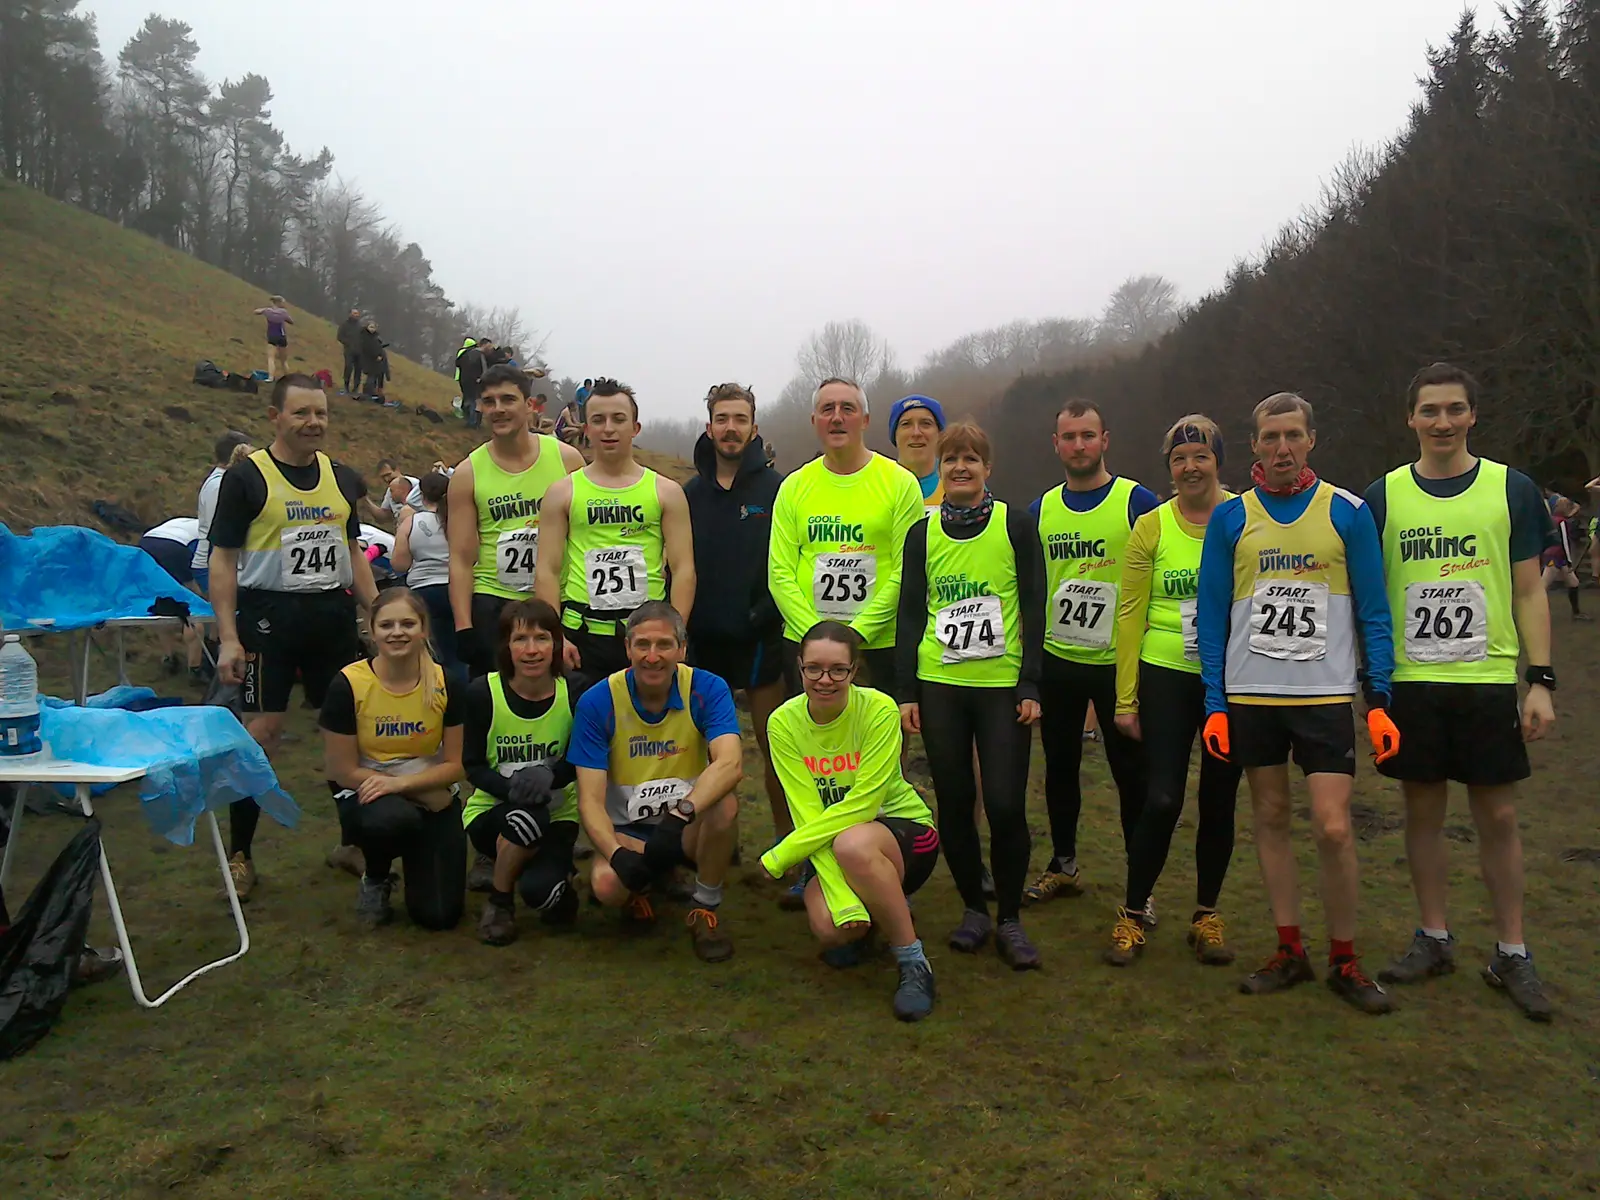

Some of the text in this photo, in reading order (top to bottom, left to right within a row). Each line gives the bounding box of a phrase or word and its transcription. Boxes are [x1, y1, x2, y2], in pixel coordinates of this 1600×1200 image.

[487, 493, 523, 506] GOOLE
[286, 506, 332, 521] VIKING
[587, 505, 644, 525] VIKING
[808, 515, 841, 523] GOOLE
[295, 530, 330, 541] START
[508, 533, 537, 542] STAR
[808, 524, 863, 543] VIKING
[1047, 532, 1081, 542] GOOLE
[1400, 526, 1443, 540] GOOLE
[839, 543, 876, 553] Striders
[1048, 539, 1106, 561] VIKING
[1258, 548, 1281, 556] GOOLE
[1400, 534, 1477, 563] VIKING
[290, 545, 337, 574] 244
[504, 547, 535, 573] 24
[595, 551, 629, 563] START
[826, 558, 862, 568] START
[1260, 553, 1316, 573] VIKING
[1079, 558, 1117, 574] Striders
[1439, 558, 1491, 577] Striders
[592, 566, 636, 596] 251
[935, 574, 966, 584] GOOLE
[820, 573, 867, 602] 253
[937, 581, 991, 603] VIKING
[1066, 584, 1102, 596] START
[1266, 586, 1311, 598] START
[1419, 587, 1465, 599] START
[948, 603, 983, 619] START
[1059, 598, 1107, 629] 247
[1259, 603, 1316, 638] 245
[1414, 606, 1474, 639] 262
[944, 619, 996, 650] 274
[375, 721, 426, 737] VIKING
[496, 734, 532, 744] GOOLE
[497, 740, 559, 763] VIKING
[630, 740, 676, 758] VIKING
[640, 784, 677, 798] START
